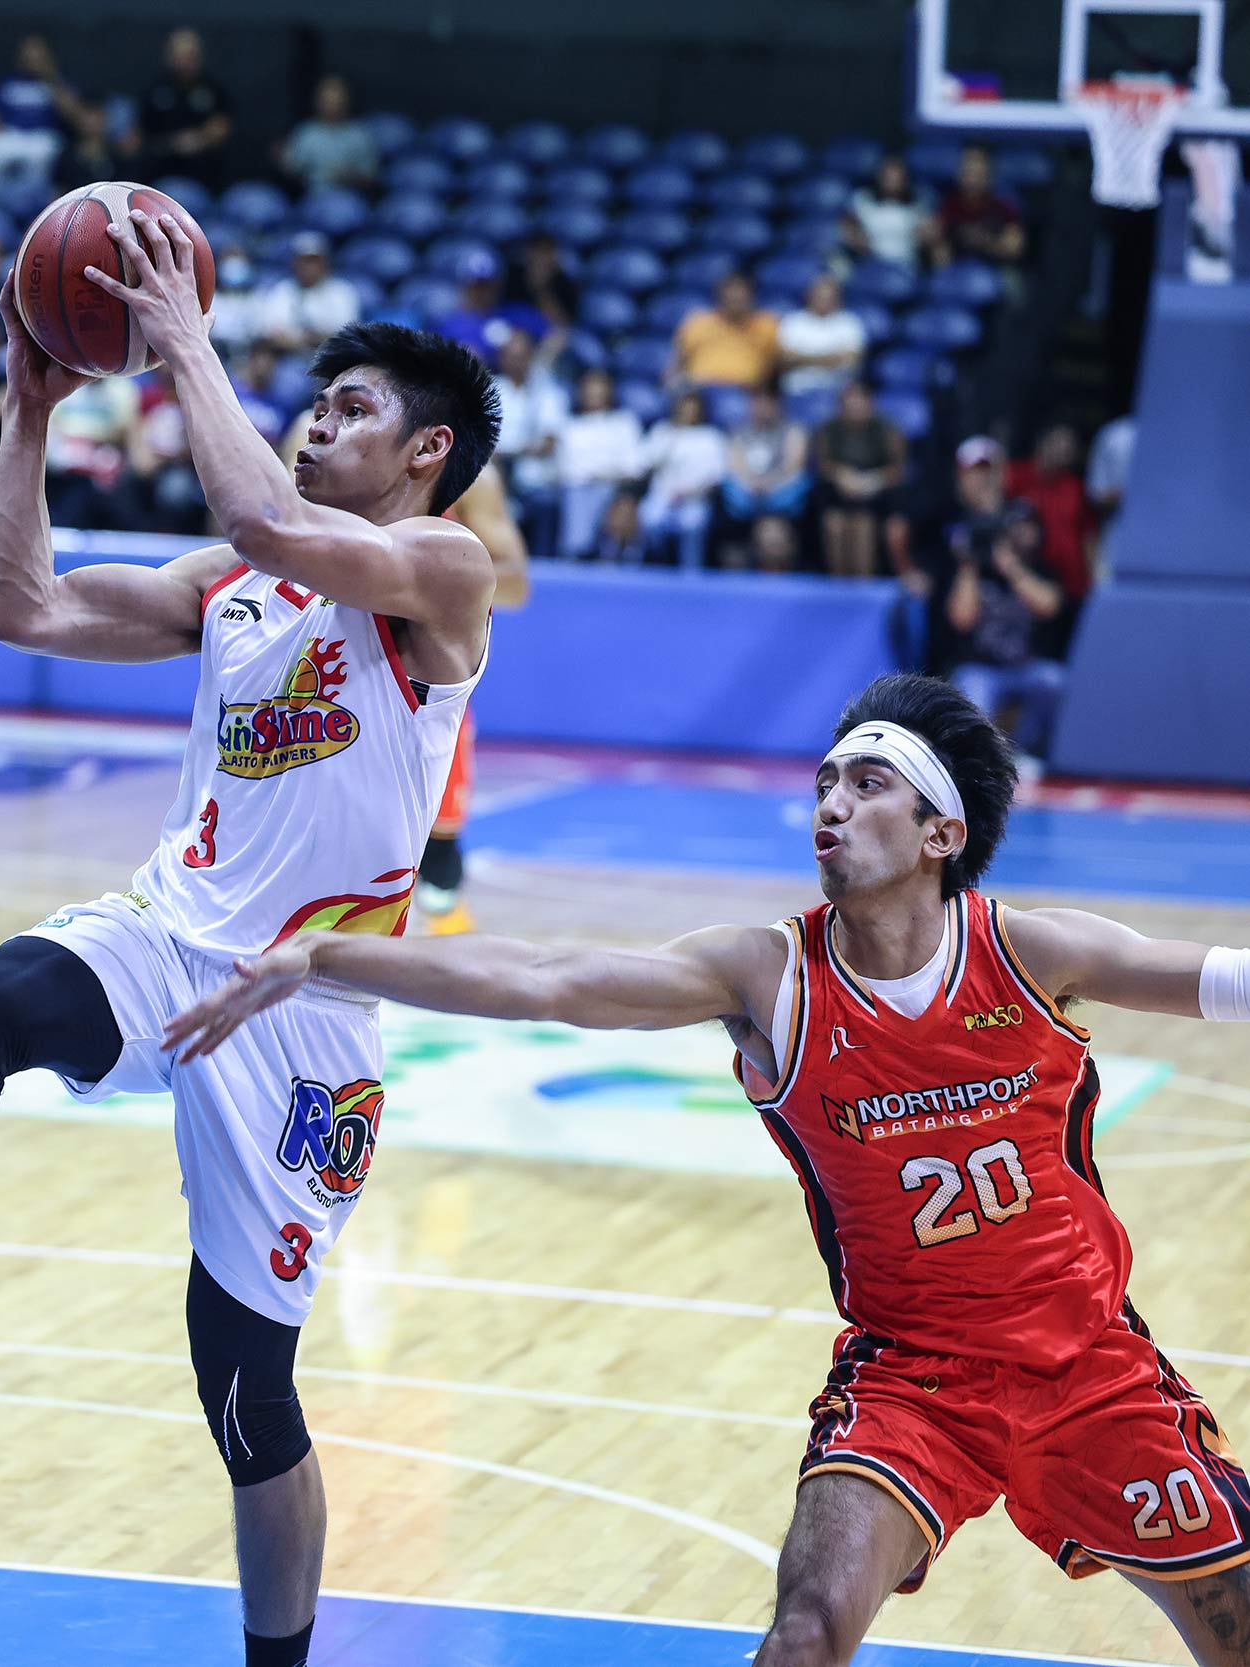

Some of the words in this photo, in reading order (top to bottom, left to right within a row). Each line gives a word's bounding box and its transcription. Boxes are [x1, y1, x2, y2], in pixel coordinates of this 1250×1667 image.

[220, 607, 248, 622] ANTA
[218, 693, 251, 753] ain
[183, 797, 219, 869] 3
[857, 1060, 1041, 1124] NORTHPORT
[872, 1113, 973, 1138] BATANG
[306, 1176, 331, 1209] ELASTO
[900, 1137, 1033, 1248] 20
[270, 1222, 312, 1282] 3
[1122, 1466, 1211, 1540] 20
